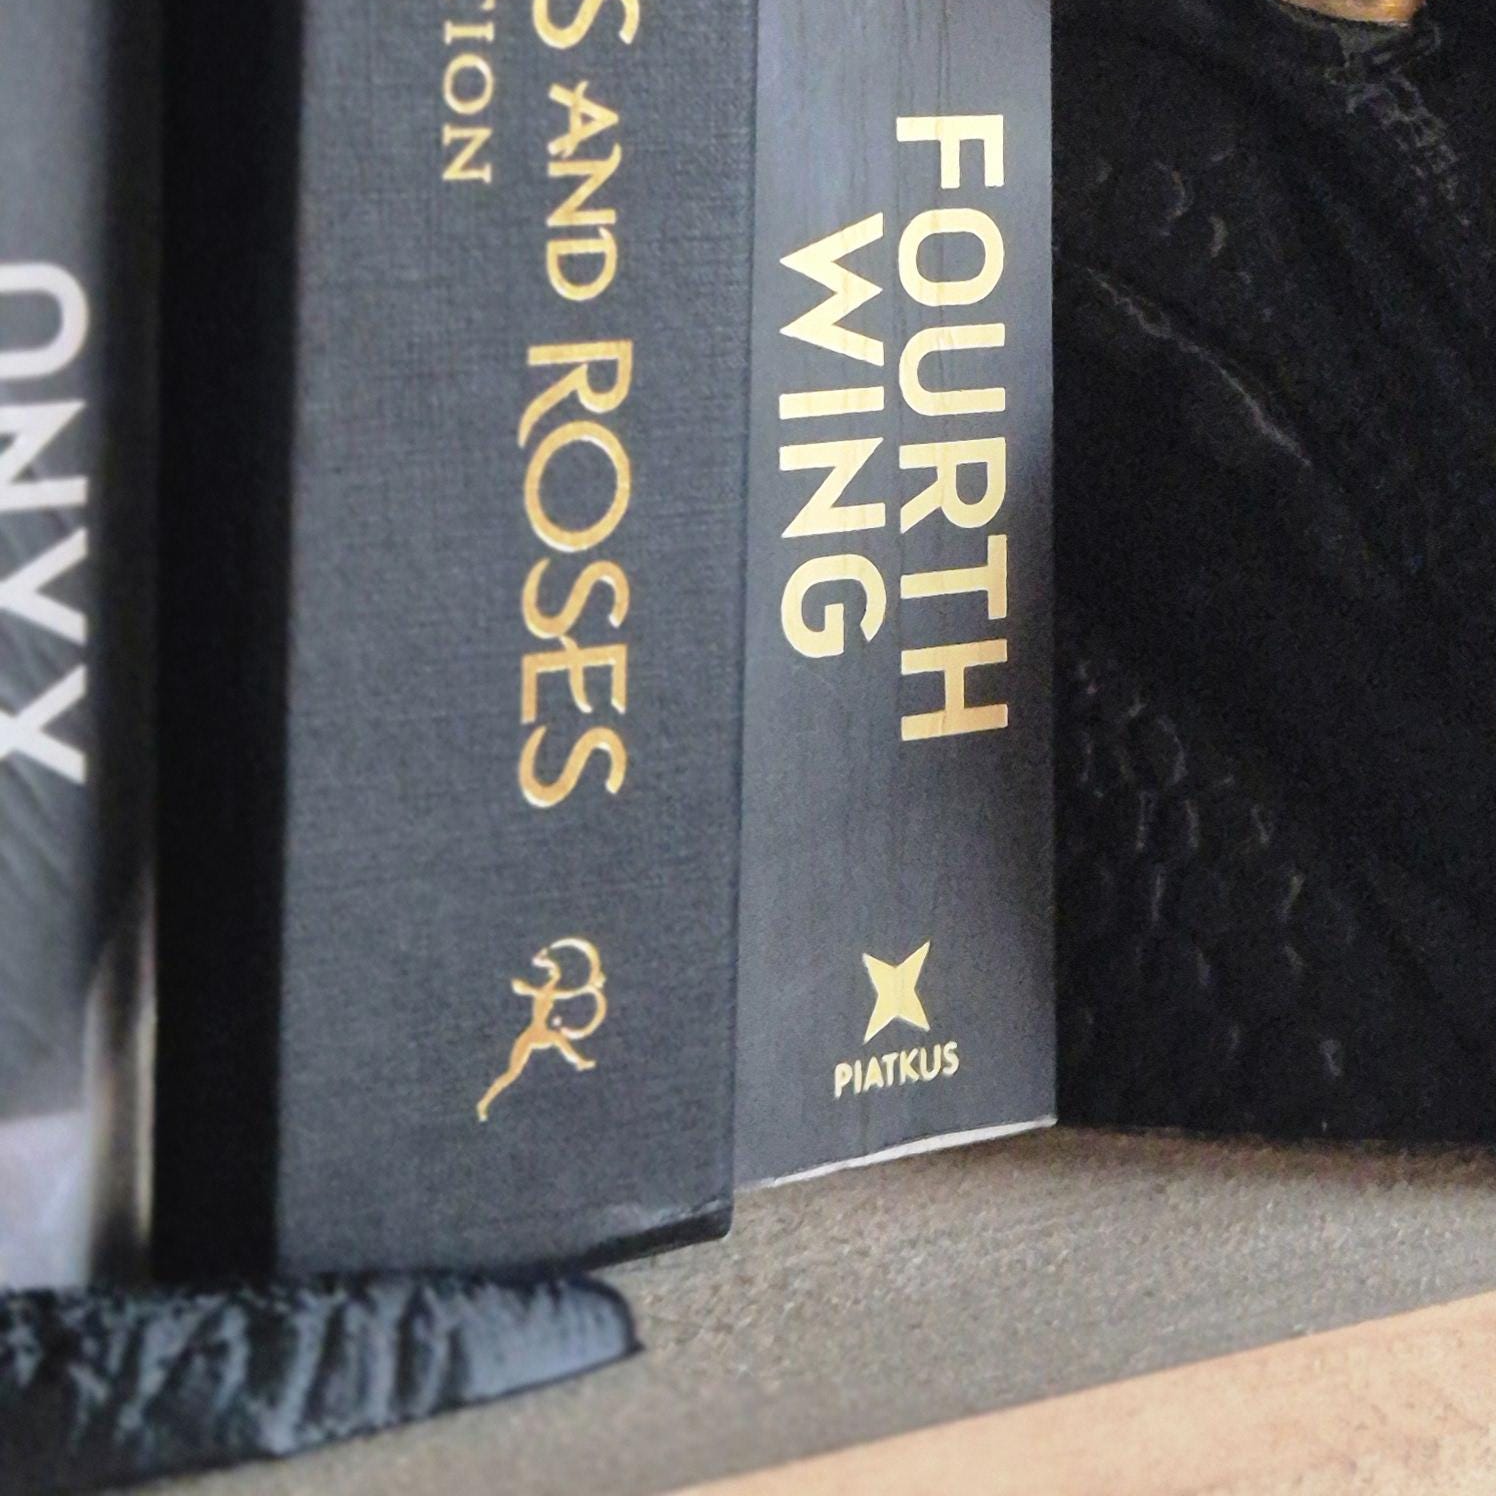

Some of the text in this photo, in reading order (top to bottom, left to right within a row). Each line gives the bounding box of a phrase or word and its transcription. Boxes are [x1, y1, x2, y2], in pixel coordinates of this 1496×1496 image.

[545, 80, 623, 302] AND
[517, 338, 634, 810] ROSES
[778, 211, 887, 659] WING
[896, 113, 1008, 741] FOURTH
[833, 1040, 961, 1100] PIATKUS
